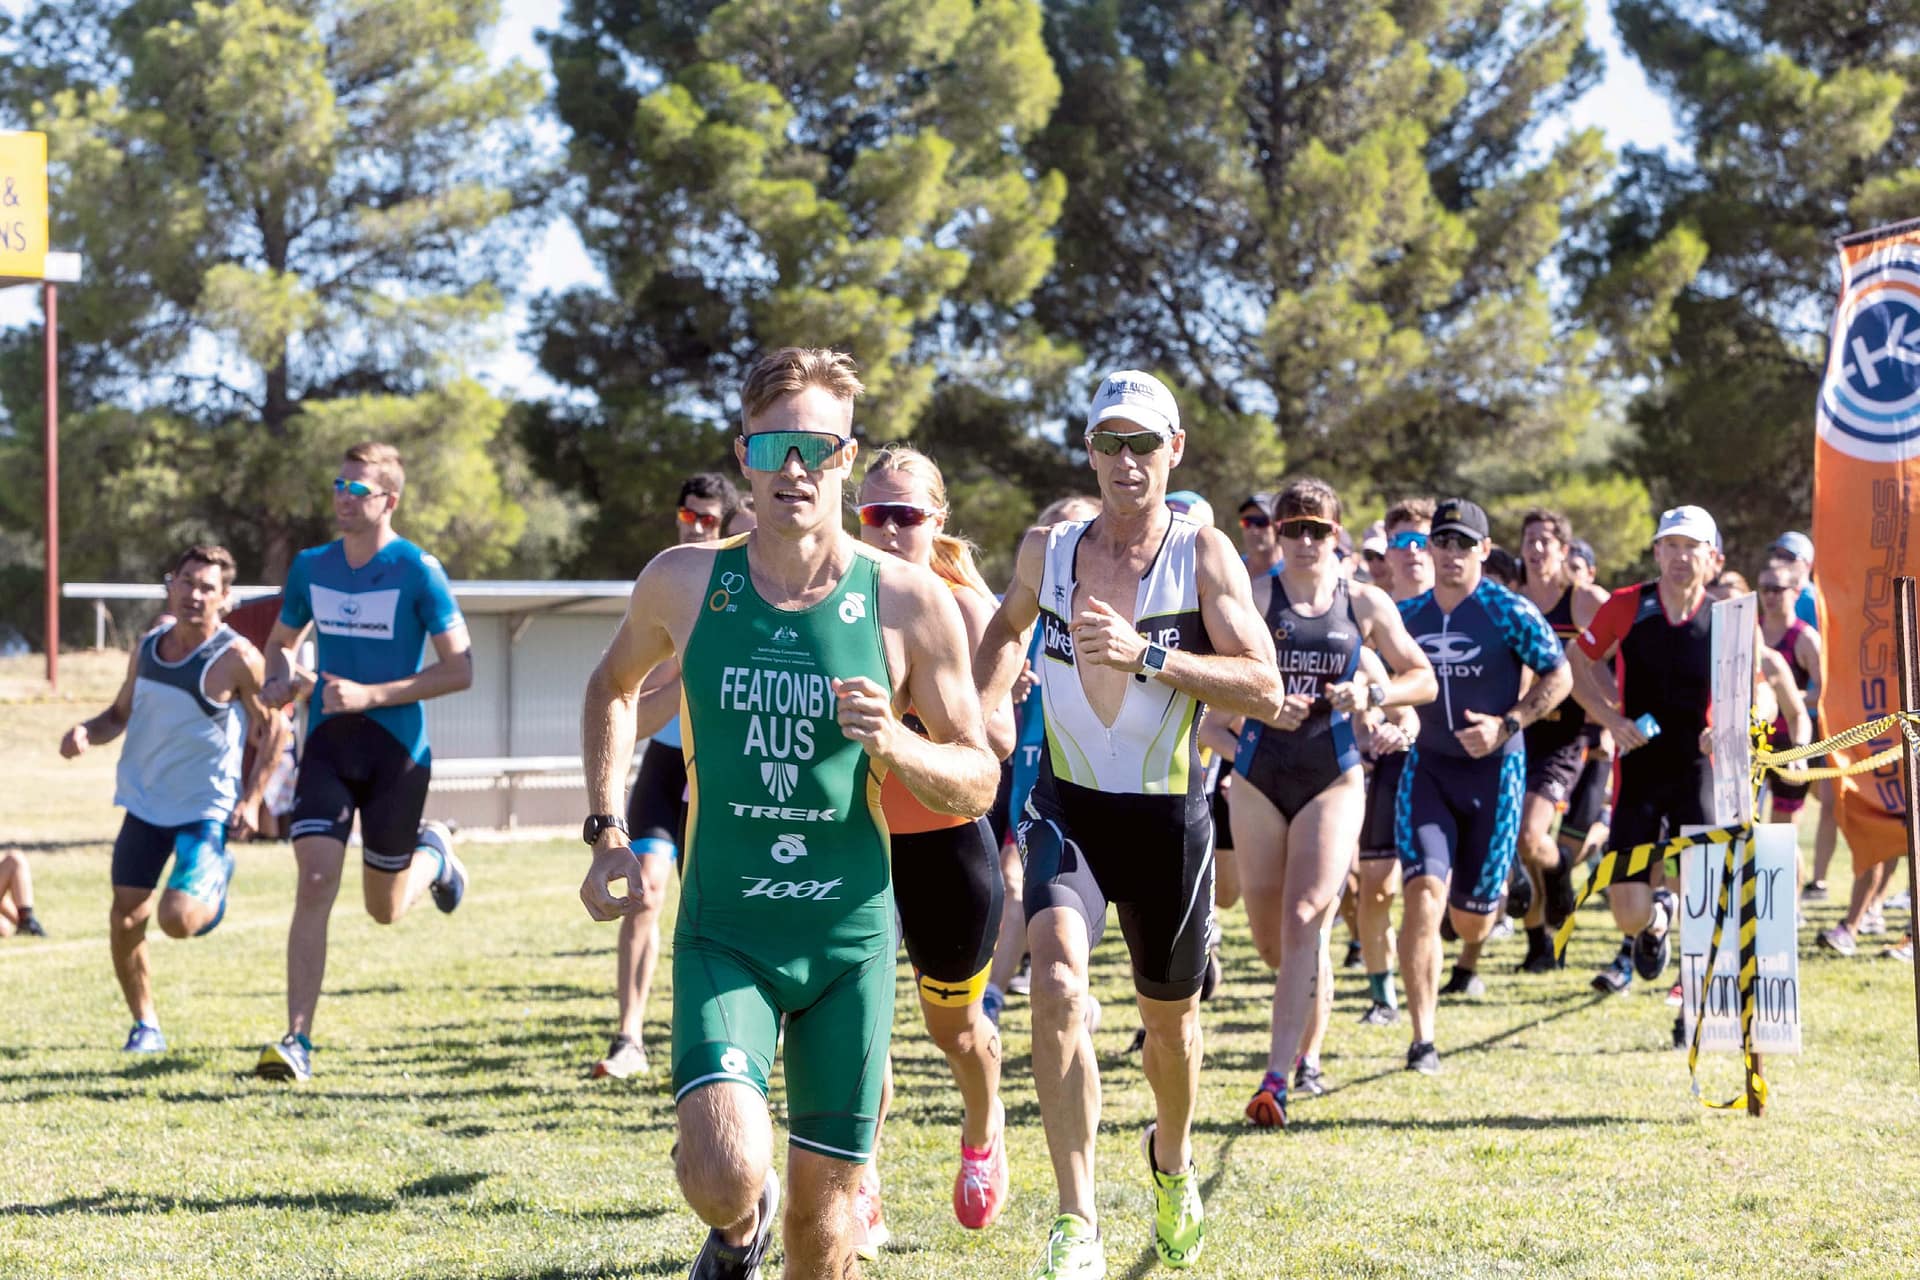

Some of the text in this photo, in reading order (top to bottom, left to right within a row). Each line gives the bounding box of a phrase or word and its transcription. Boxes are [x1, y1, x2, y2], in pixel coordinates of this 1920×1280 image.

[3, 176, 19, 206] &
[1278, 650, 1346, 674] LLEWELLYN
[720, 666, 837, 720] FEATONBY
[1286, 675, 1322, 698] NZL
[743, 714, 815, 760] AUS
[728, 802, 838, 821] TREK
